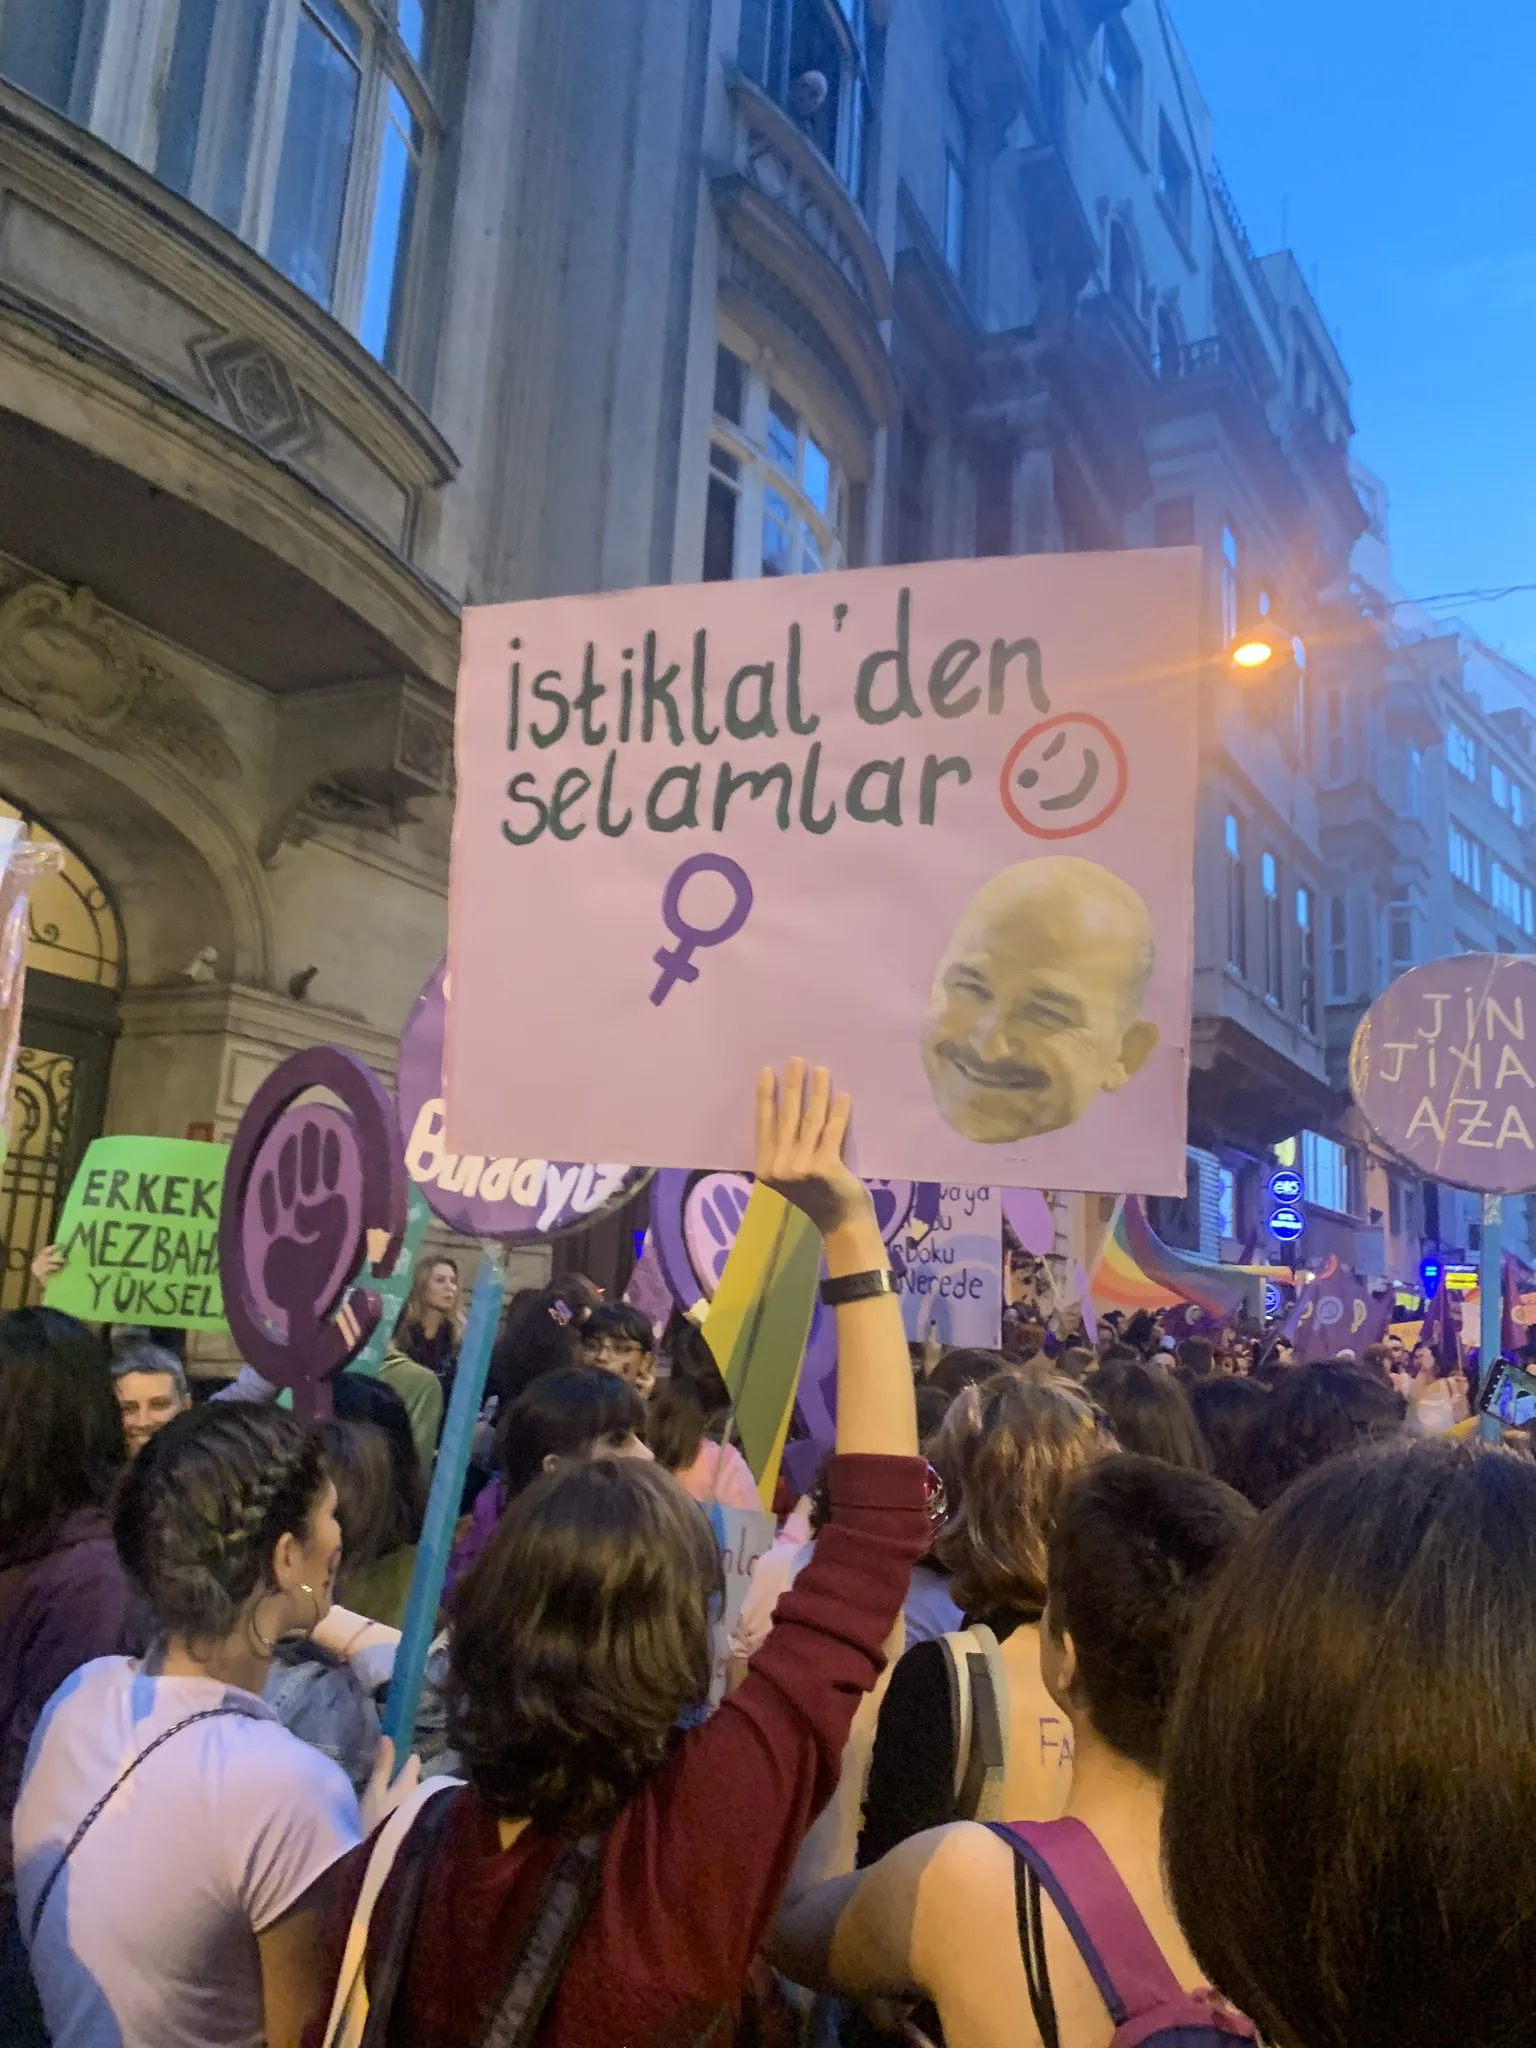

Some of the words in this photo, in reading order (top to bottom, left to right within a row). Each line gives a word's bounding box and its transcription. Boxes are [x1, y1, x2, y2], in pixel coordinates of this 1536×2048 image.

[505, 586, 1052, 751] istiklal'den
[501, 742, 974, 846] selamlar
[81, 1168, 220, 1220] ERKEK
[61, 1219, 221, 1278] MEZBAH
